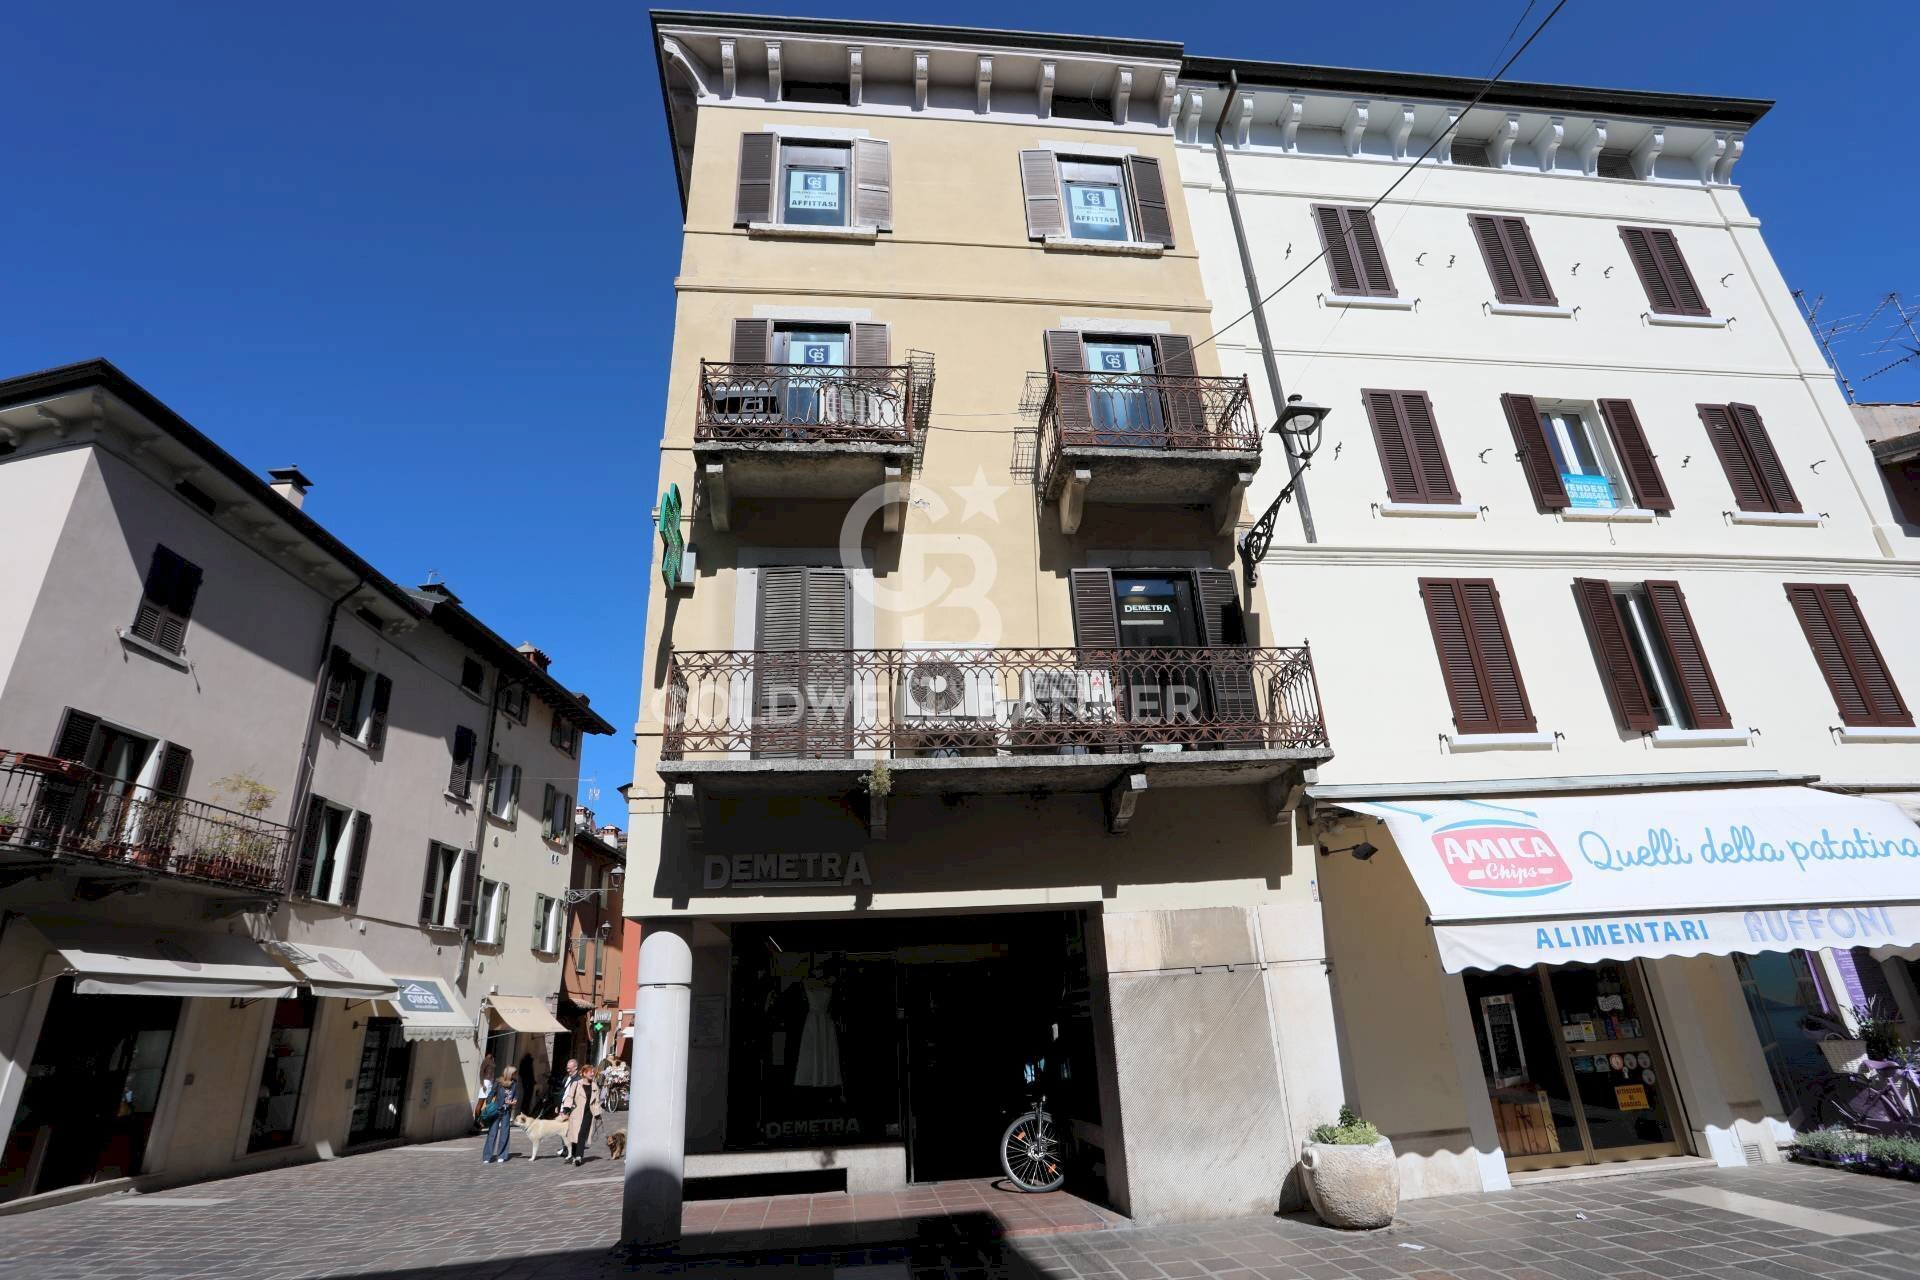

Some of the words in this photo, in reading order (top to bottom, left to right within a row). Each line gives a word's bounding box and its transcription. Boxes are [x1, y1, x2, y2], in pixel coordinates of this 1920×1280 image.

[791, 199, 837, 208] AFFITTASI
[1075, 214, 1119, 224] AFFITTASI
[1123, 604, 1172, 613] DEMETRA
[1443, 836, 1557, 865] AMICA
[1578, 827, 1693, 872] Quelli
[1699, 825, 1785, 864] della
[1786, 827, 1920, 872] patatina
[703, 851, 872, 890] DEMETRA
[1485, 862, 1539, 884] Chips
[1536, 918, 1710, 950] ALIMENTARI
[407, 994, 438, 1005] OIKOS
[765, 1117, 861, 1139] DEMETRA
